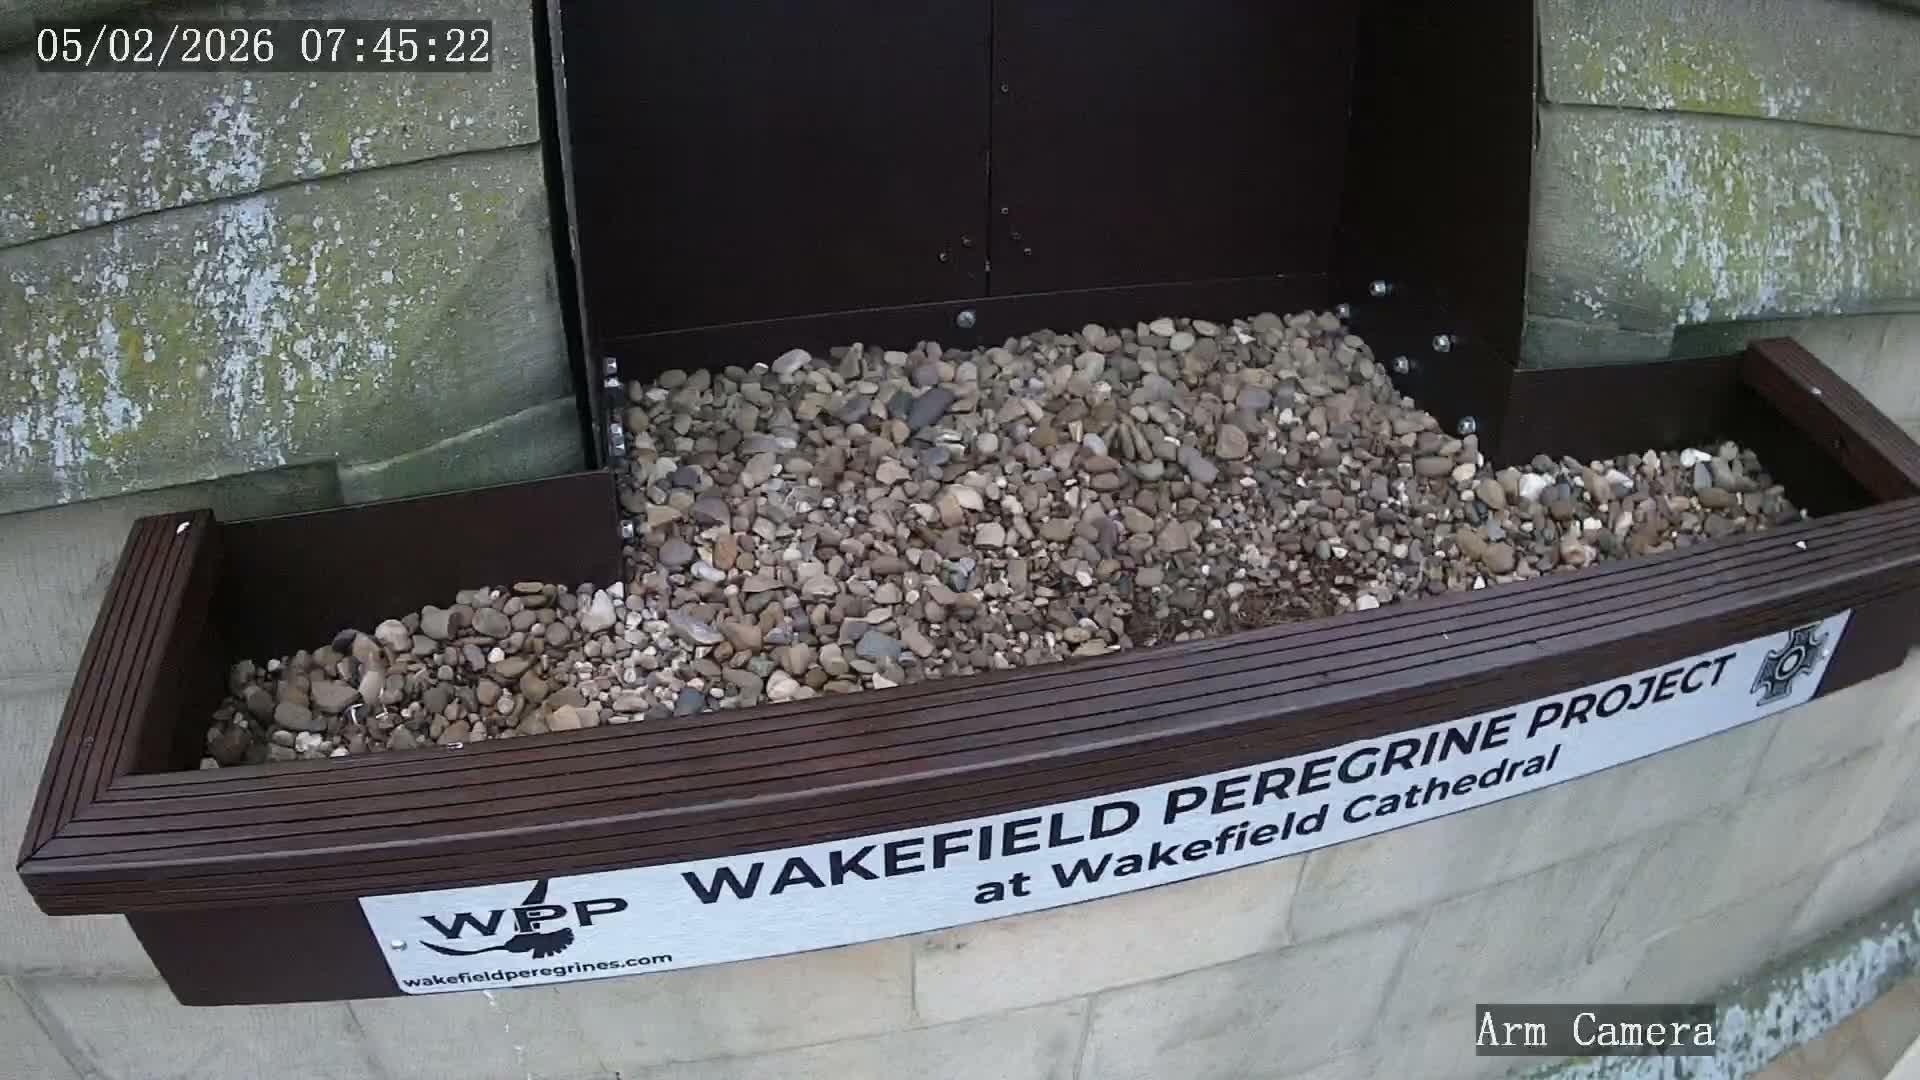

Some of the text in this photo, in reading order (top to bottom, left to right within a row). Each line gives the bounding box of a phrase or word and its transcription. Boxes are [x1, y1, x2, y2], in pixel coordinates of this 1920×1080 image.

[681, 652, 1737, 905] WAKEFIELD PEREGRINE PROJECT
[974, 744, 1561, 906] at Wakefield Cathedral
[420, 897, 629, 940] WPP
[402, 952, 673, 989] wakefieldperegrines.com
